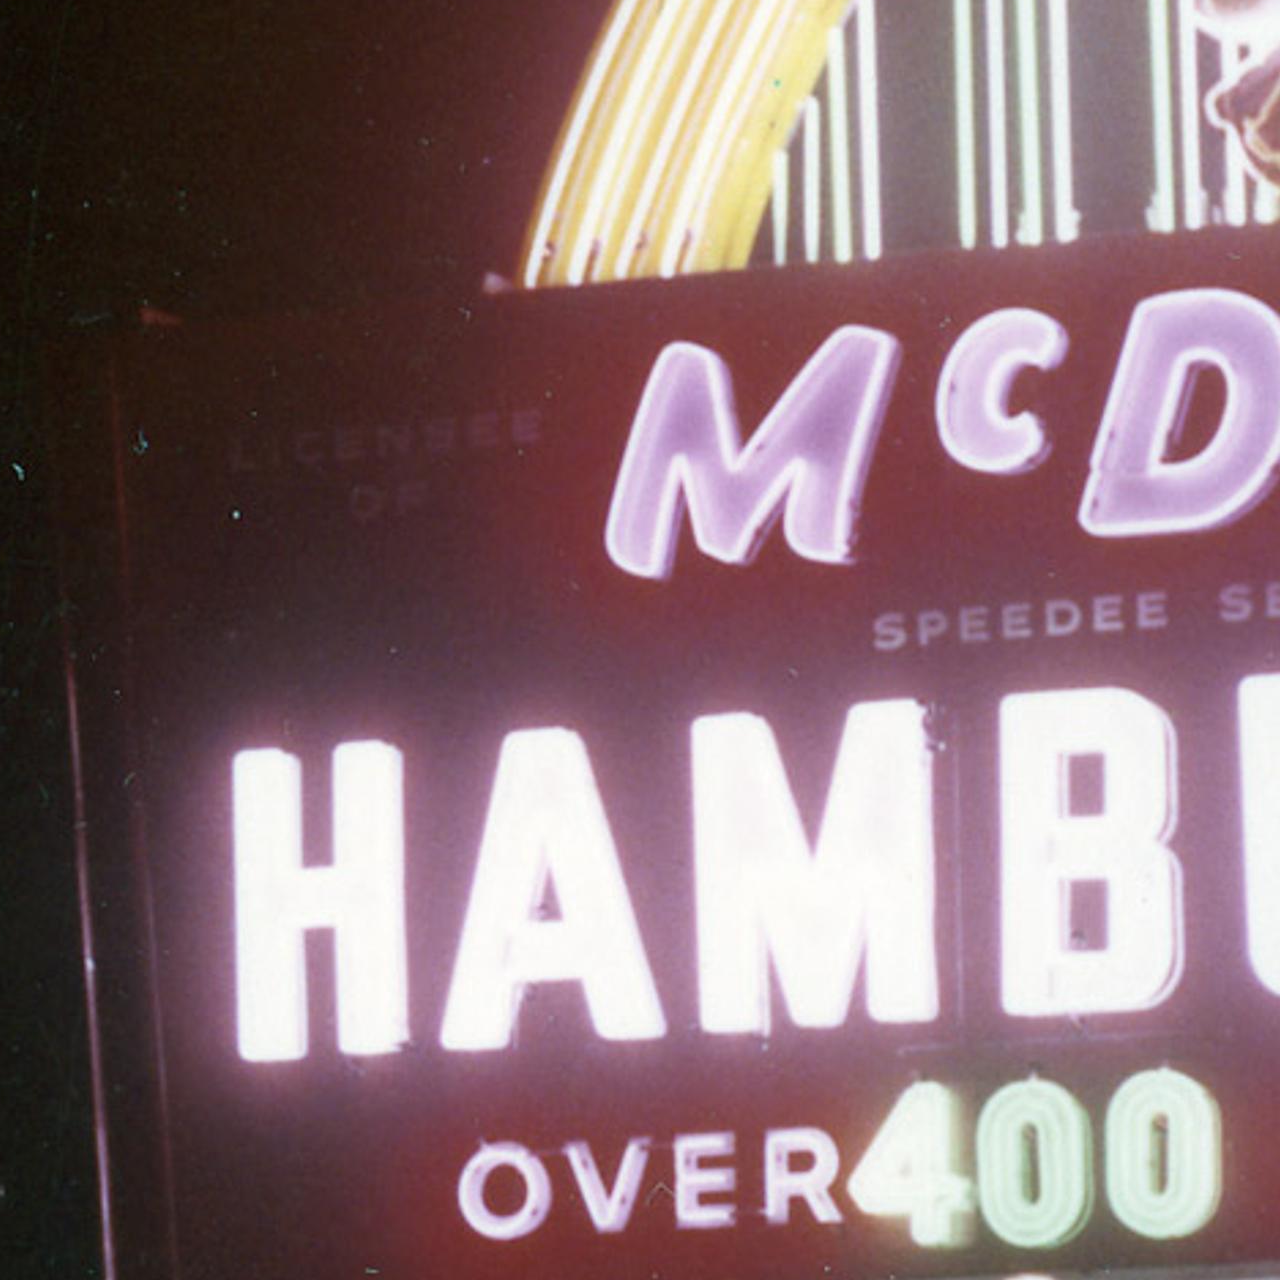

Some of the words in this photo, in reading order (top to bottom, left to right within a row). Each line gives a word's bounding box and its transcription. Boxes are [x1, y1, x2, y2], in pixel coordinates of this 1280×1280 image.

[872, 590, 1169, 652] SPEEDEE
[232, 672, 1280, 1062] HAMB
[457, 1125, 843, 1242] OVER
[845, 1066, 1223, 1249] 400
